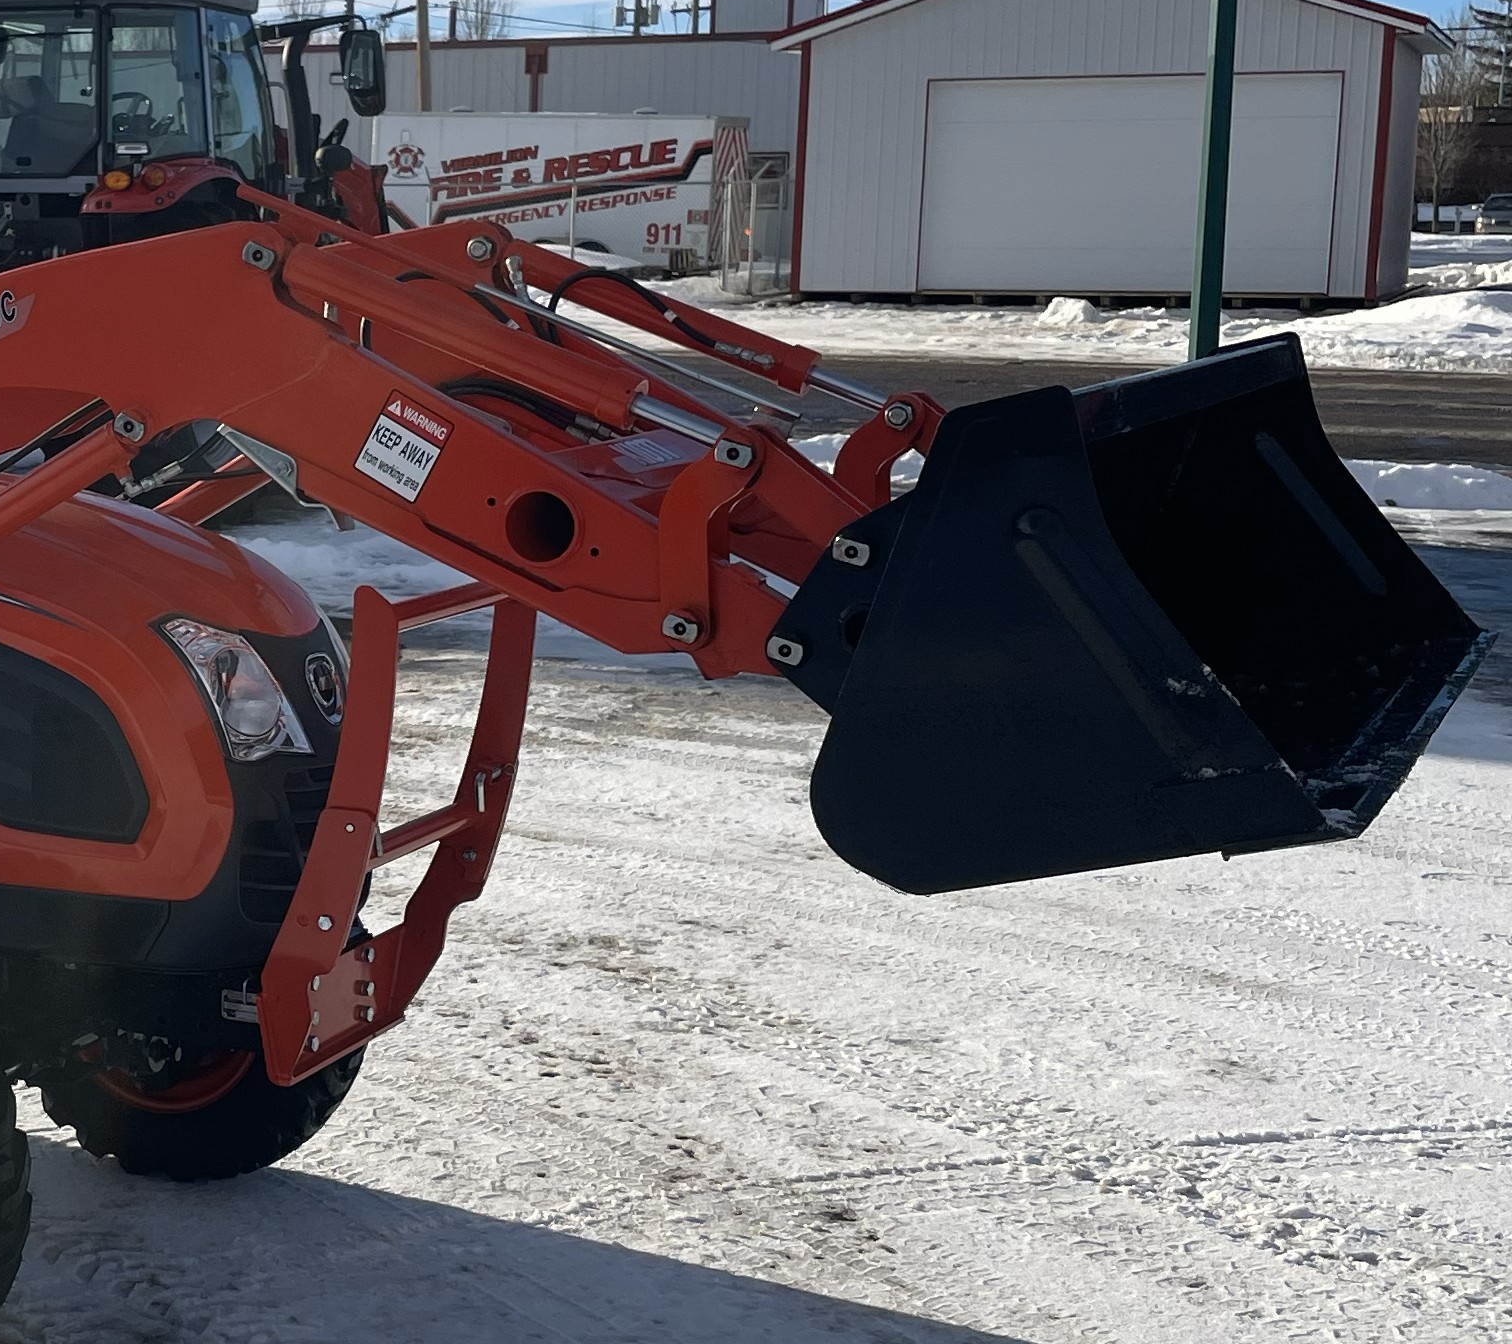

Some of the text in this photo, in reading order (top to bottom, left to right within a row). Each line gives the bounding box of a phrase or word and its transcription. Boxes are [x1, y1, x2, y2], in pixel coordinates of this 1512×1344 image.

[430, 138, 678, 201] FIRE & RESCUE
[575, 186, 678, 214] RESPONSE
[646, 222, 681, 245] 911
[402, 405, 447, 441] WARNING
[372, 423, 434, 471] KEEP AWAY
[361, 447, 420, 492] from working area
